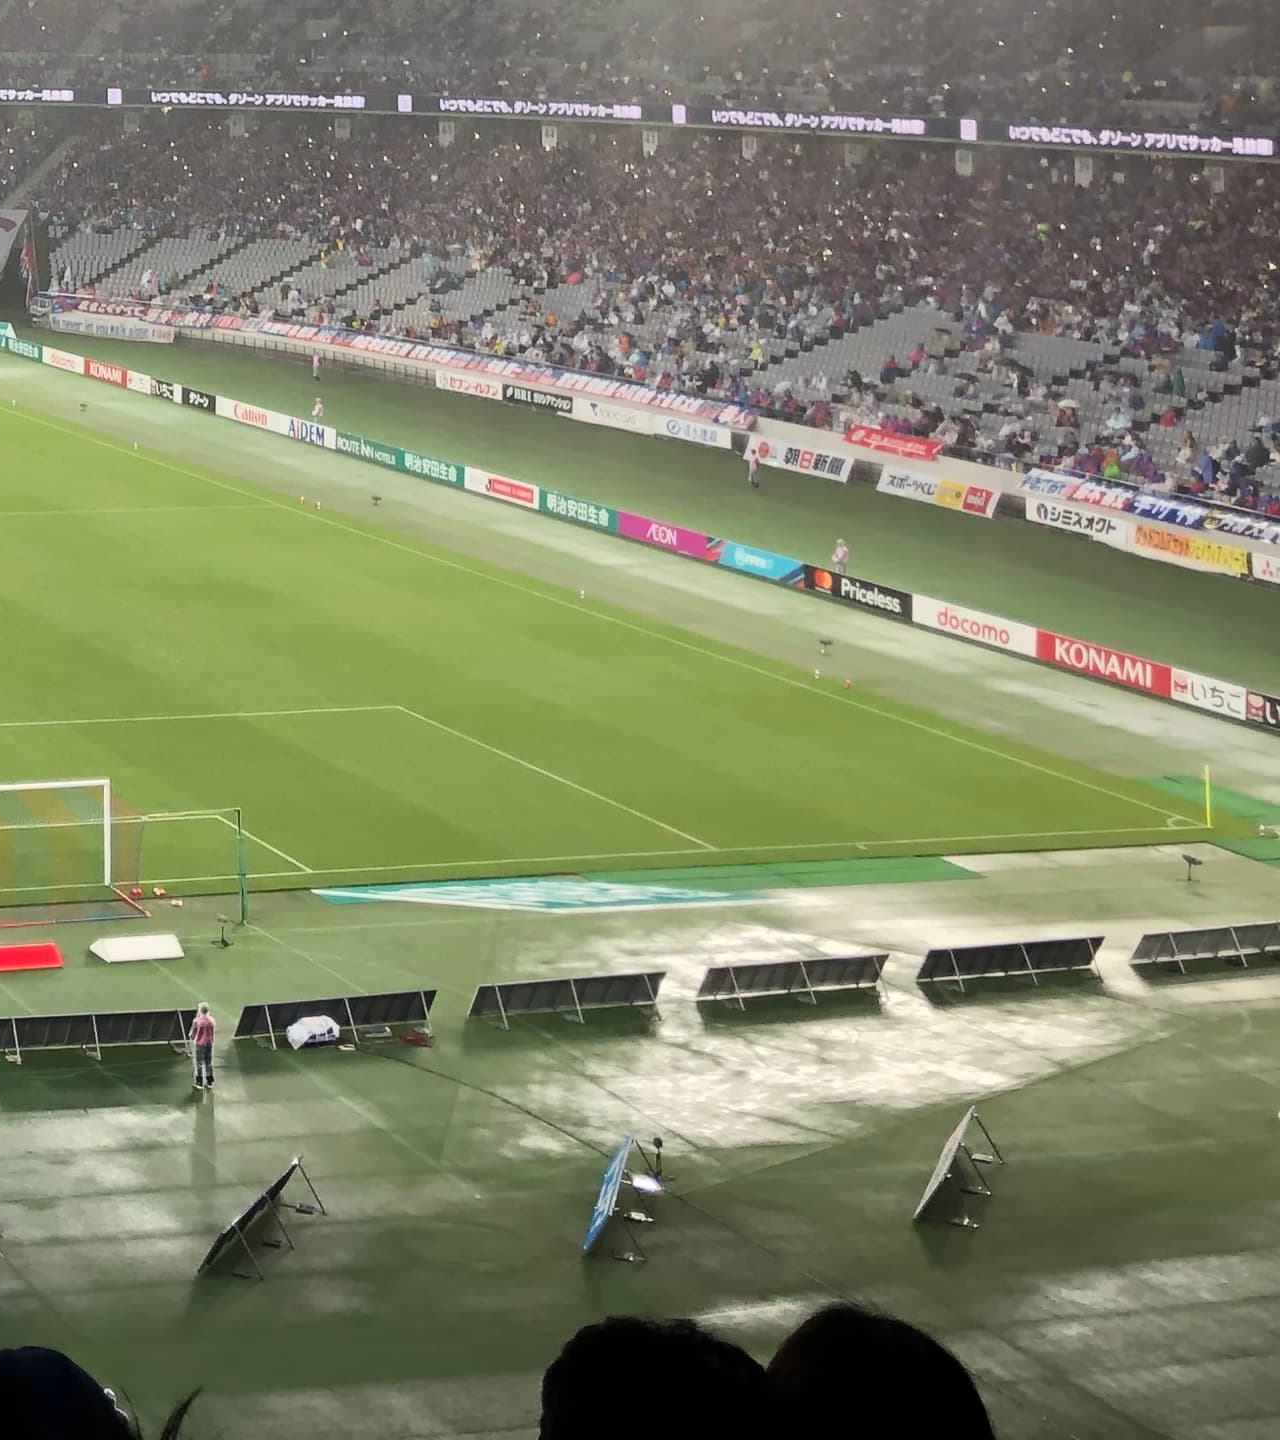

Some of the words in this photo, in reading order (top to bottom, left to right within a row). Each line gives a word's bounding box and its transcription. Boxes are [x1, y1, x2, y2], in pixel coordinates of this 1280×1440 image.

[89, 361, 122, 384] KONAMI
[233, 402, 268, 427] Canon
[404, 452, 457, 483] 明治安田生命
[783, 447, 846, 476] 朝日新聞
[547, 492, 609, 527] 明治安田生命
[937, 607, 1009, 645] docomo
[1054, 636, 1152, 689] KONAMI
[1190, 677, 1242, 714] いちご
